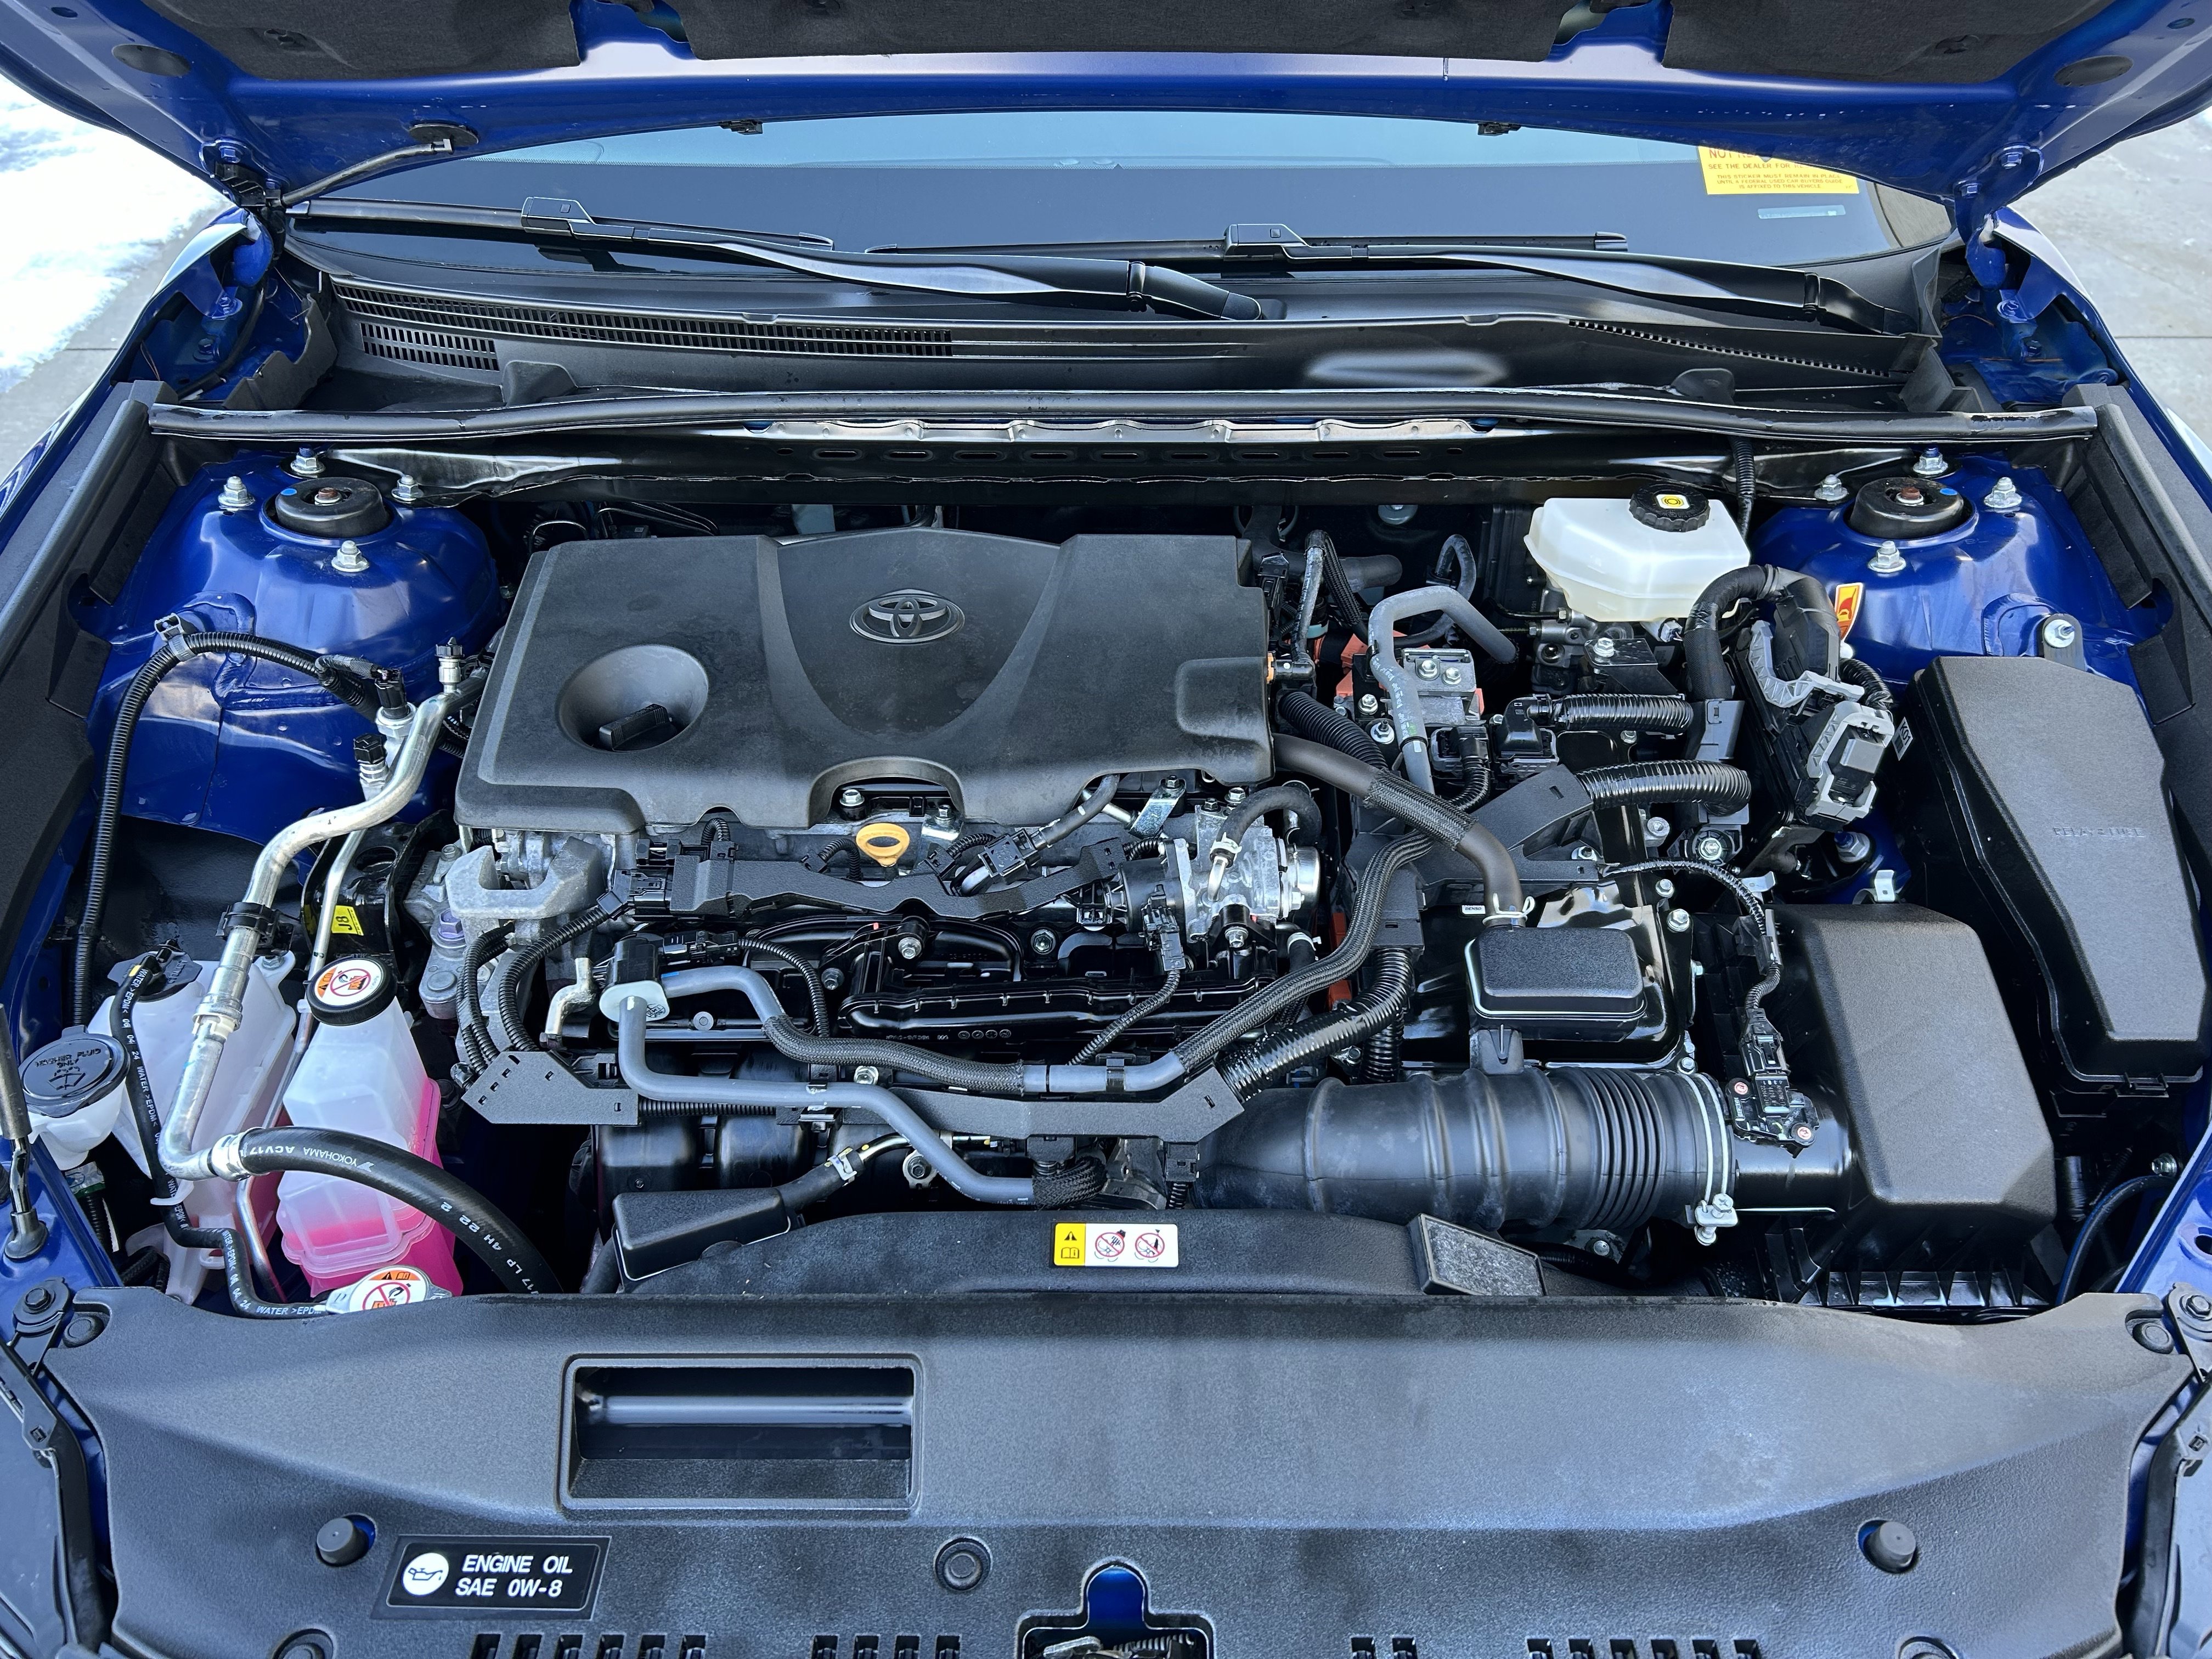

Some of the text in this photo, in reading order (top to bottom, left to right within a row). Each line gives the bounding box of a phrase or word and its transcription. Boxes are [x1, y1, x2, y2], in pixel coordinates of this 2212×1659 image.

[1900, 721, 1911, 745] K01
[336, 916, 352, 930] J8
[131, 968, 149, 988] WATER
[77, 1048, 101, 1058] FLUID
[132, 1051, 140, 1060] 24
[137, 1066, 149, 1093] WATER
[250, 1146, 295, 1155] ACV17
[303, 1147, 358, 1167] YOKOHAMA
[167, 1178, 177, 1198] WATE
[441, 1201, 453, 1212] 2
[459, 1214, 481, 1233] 22
[483, 1234, 502, 1251] 4H
[506, 1259, 523, 1274] LP
[240, 1300, 251, 1310] 24
[256, 1305, 289, 1315] WATER
[462, 1554, 573, 1574] ENGINE OIL
[455, 1577, 563, 1598] SAE 0W-8
